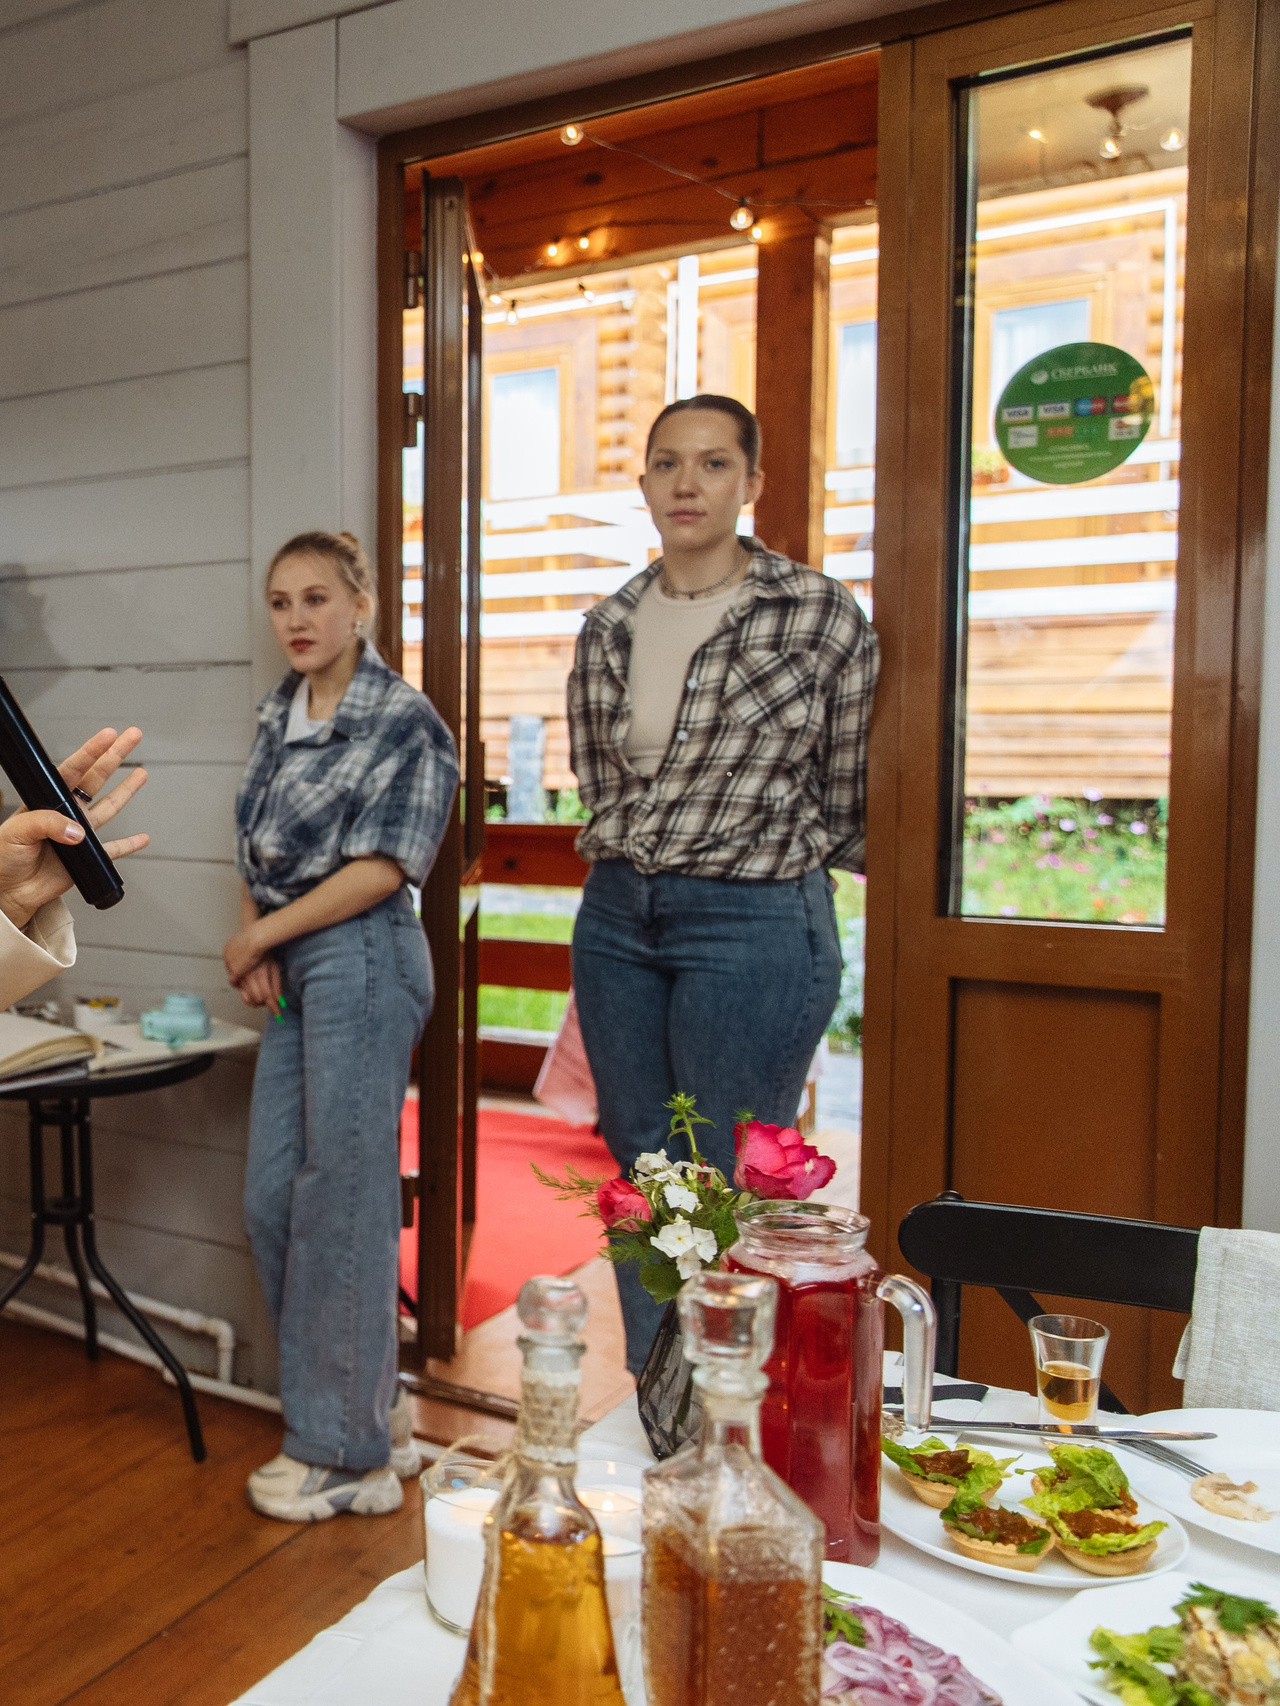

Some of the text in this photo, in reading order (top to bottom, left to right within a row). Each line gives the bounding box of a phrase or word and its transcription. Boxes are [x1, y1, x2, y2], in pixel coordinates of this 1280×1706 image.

[1051, 363, 1119, 380] СБЕРБАНК
[1007, 409, 1029, 418] VISA
[1043, 405, 1065, 414] VISA
